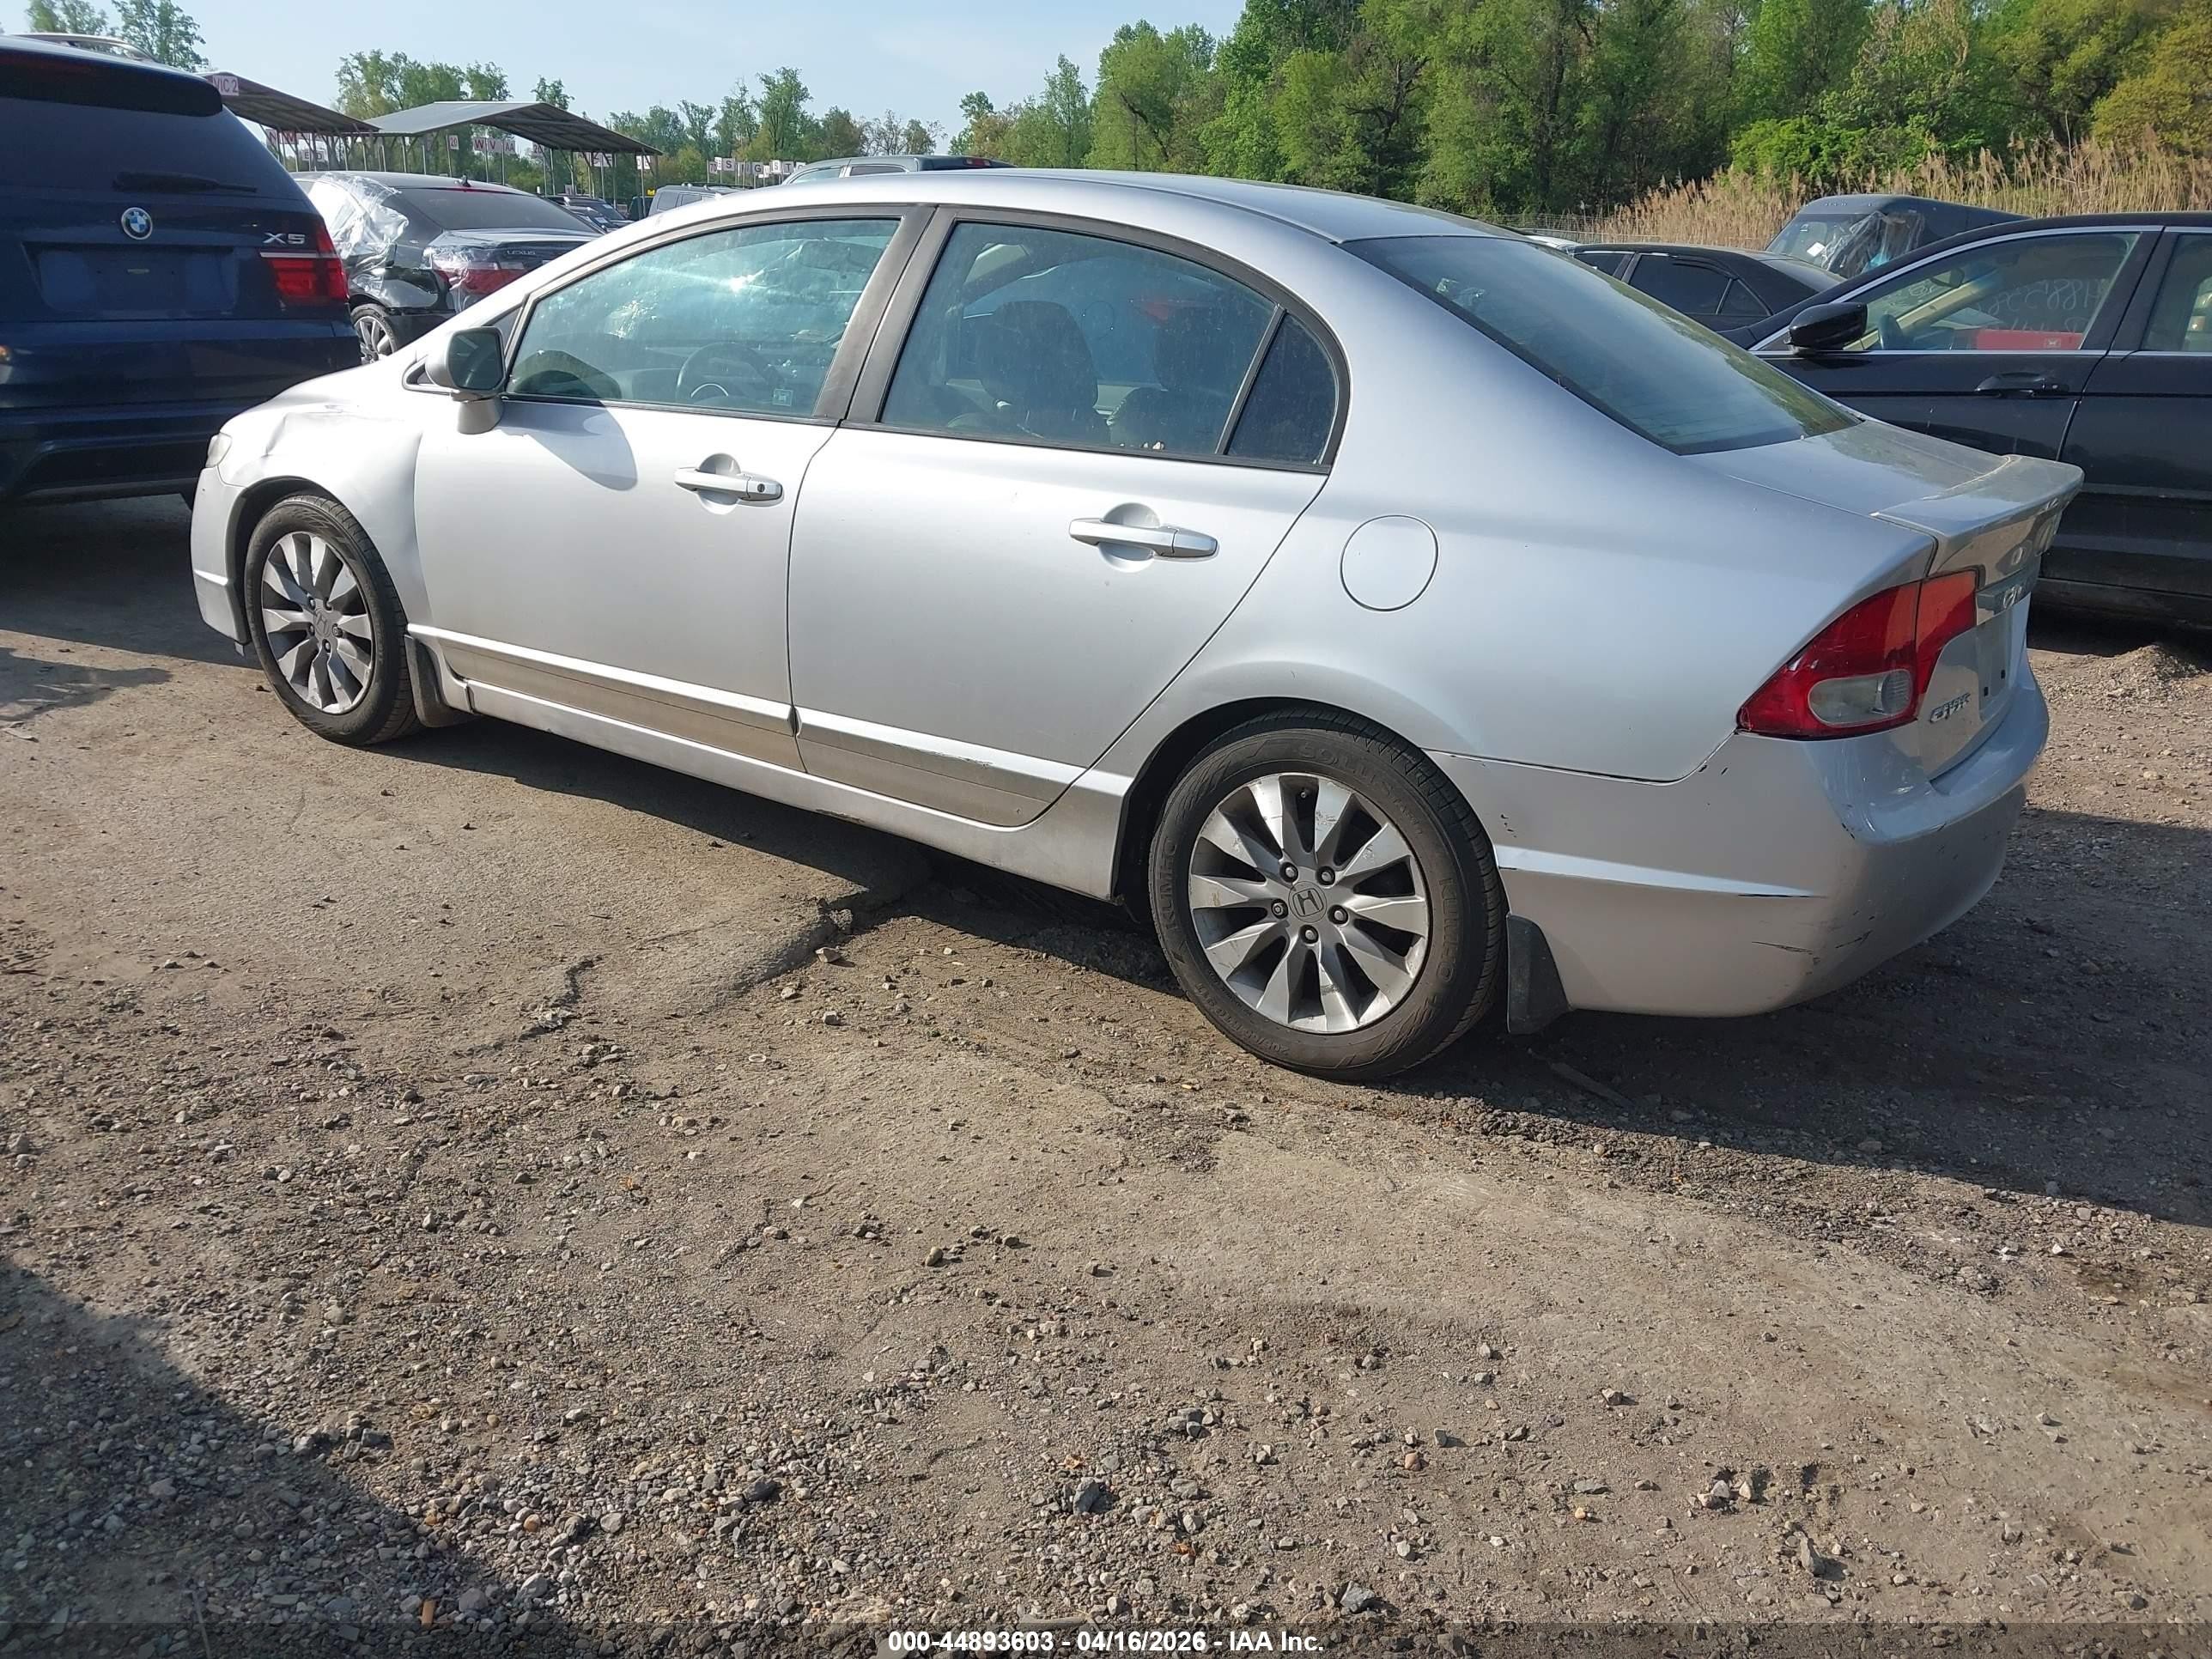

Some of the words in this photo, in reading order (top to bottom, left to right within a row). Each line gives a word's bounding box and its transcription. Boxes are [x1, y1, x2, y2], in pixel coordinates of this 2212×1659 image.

[232, 80, 238, 93] 2
[475, 139, 485, 149] W
[489, 140, 497, 149] V
[726, 160, 733, 169] S
[754, 164, 762, 173] G
[263, 232, 306, 245] X5
